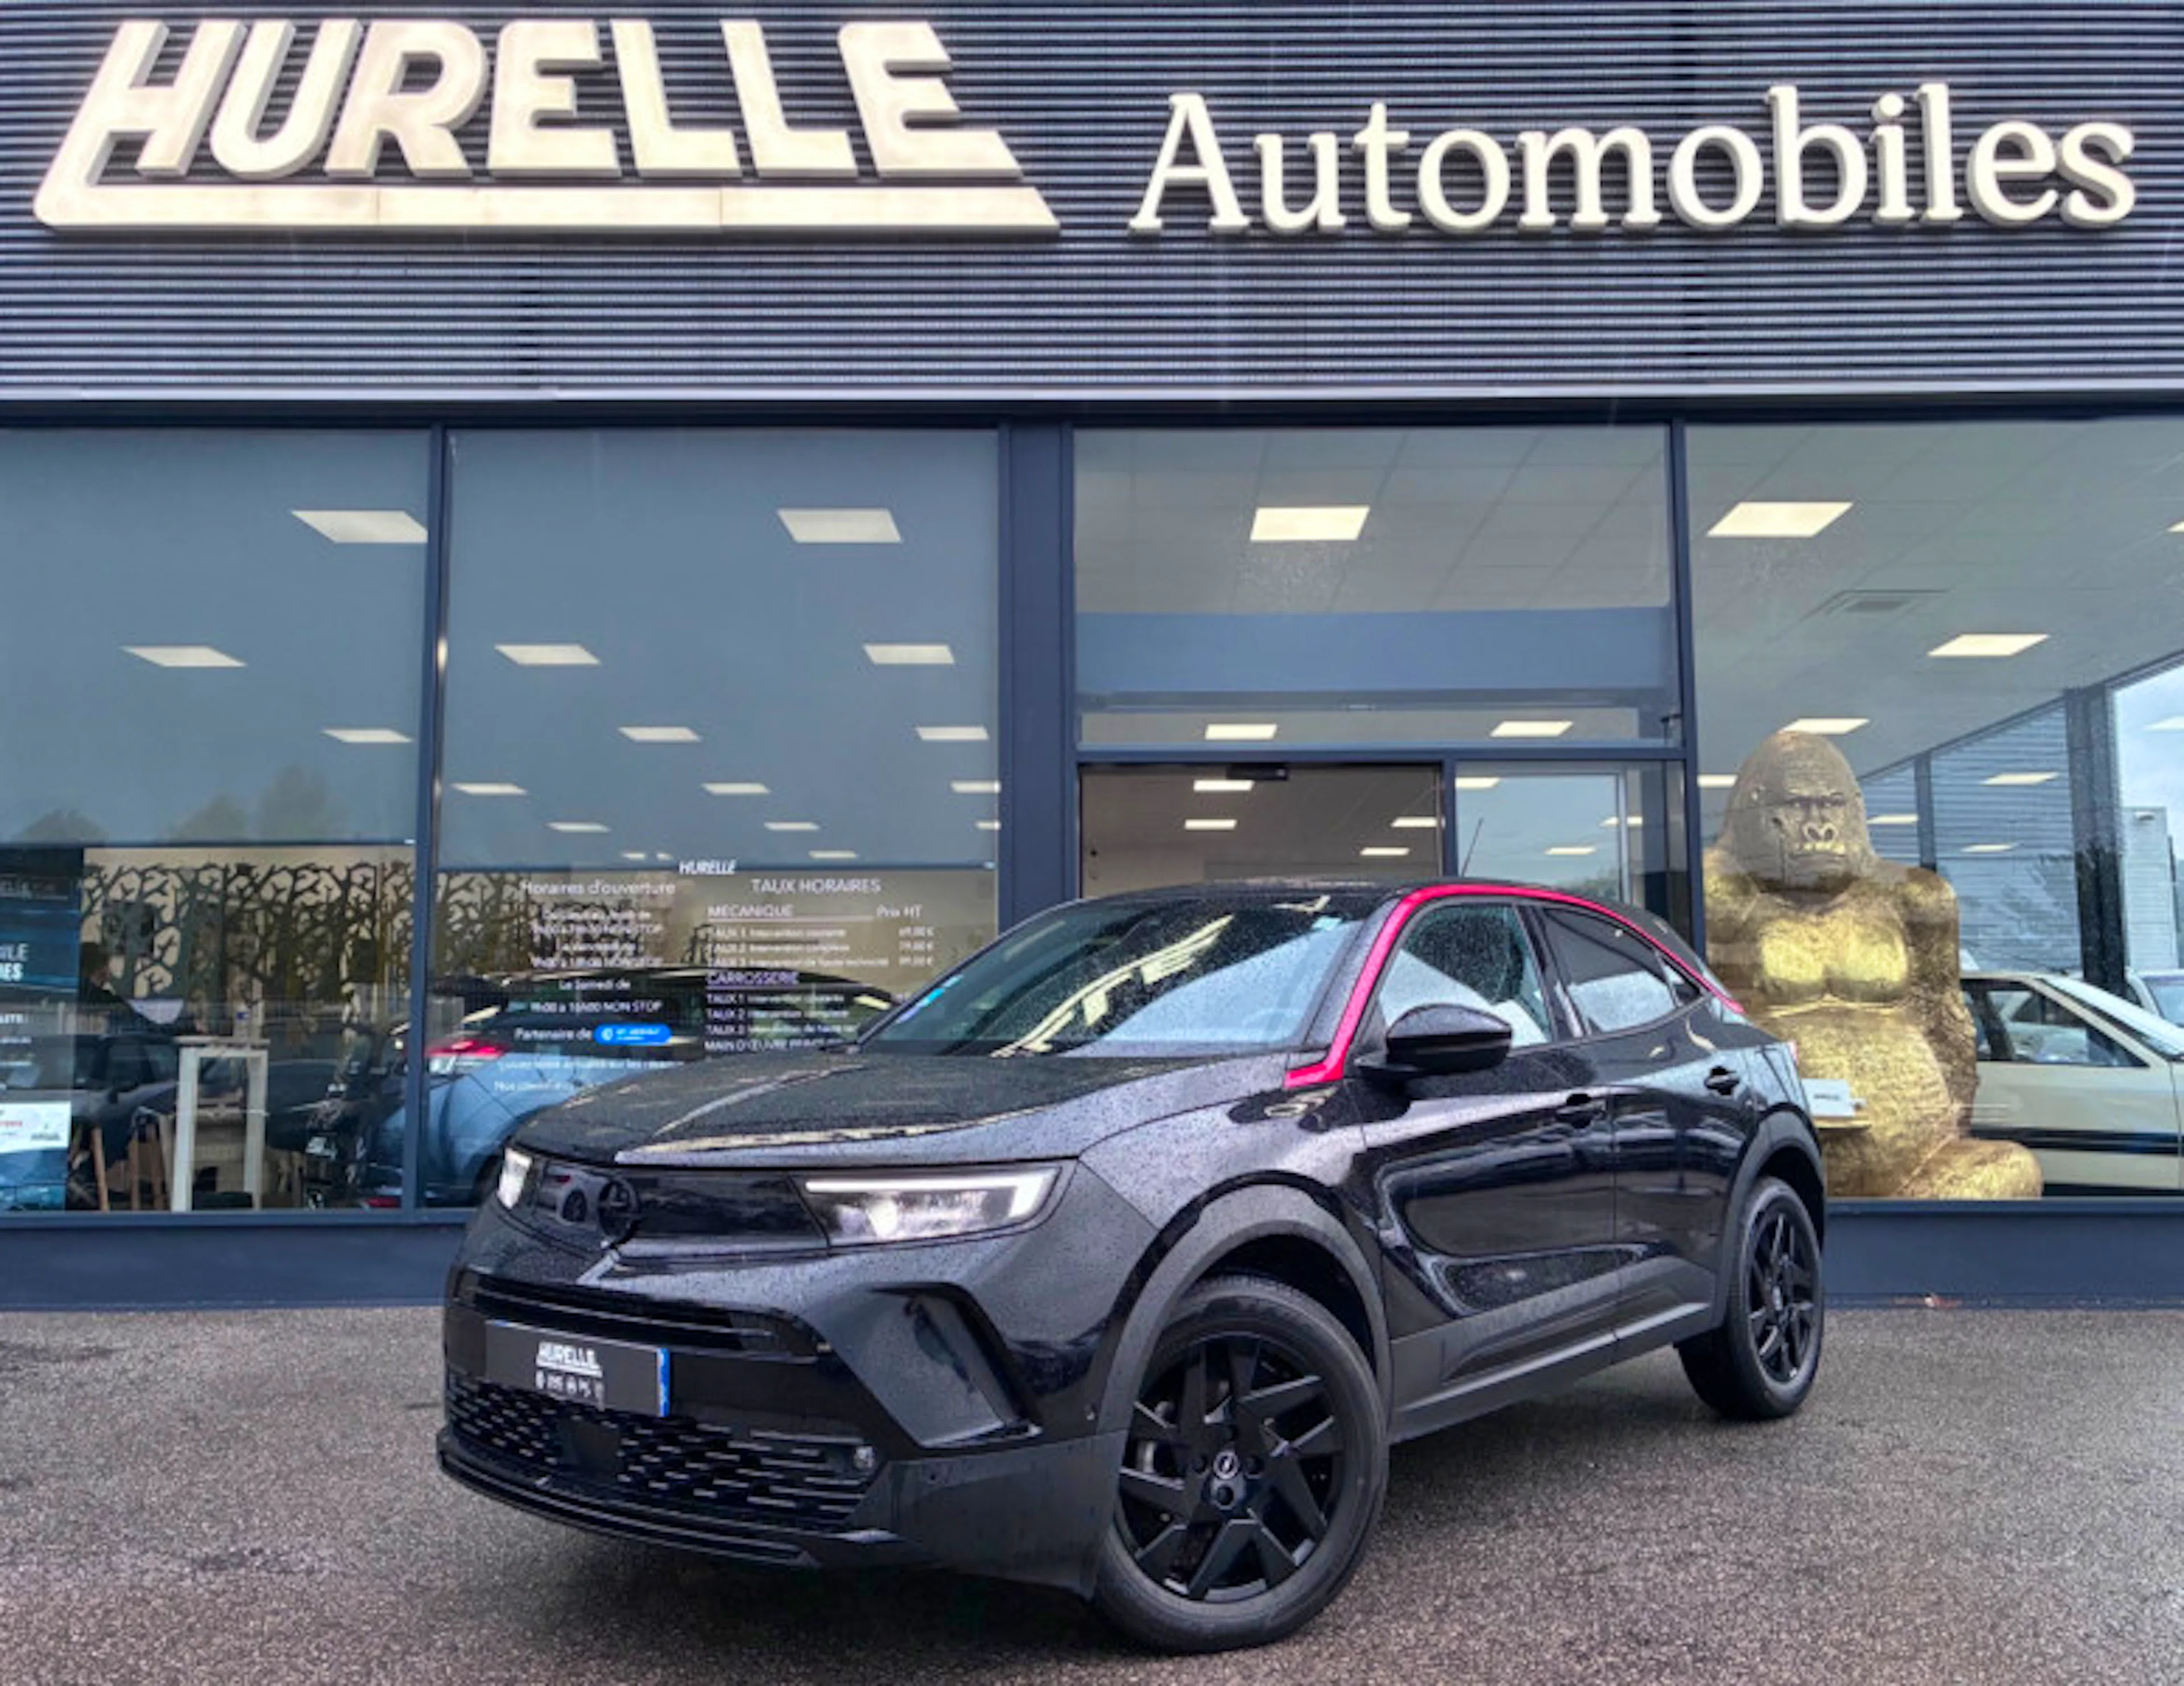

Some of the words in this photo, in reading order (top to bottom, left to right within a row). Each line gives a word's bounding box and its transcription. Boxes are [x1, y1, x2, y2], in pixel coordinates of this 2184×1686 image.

[34, 20, 1059, 233] HURELLE
[1128, 82, 2137, 239] Automobiles
[680, 859, 738, 876] HURELLE
[750, 878, 796, 894] TAUX
[799, 877, 881, 894] HORAIRES
[705, 971, 799, 985] CARROSSERIE
[514, 1026, 574, 1041] Partenaire
